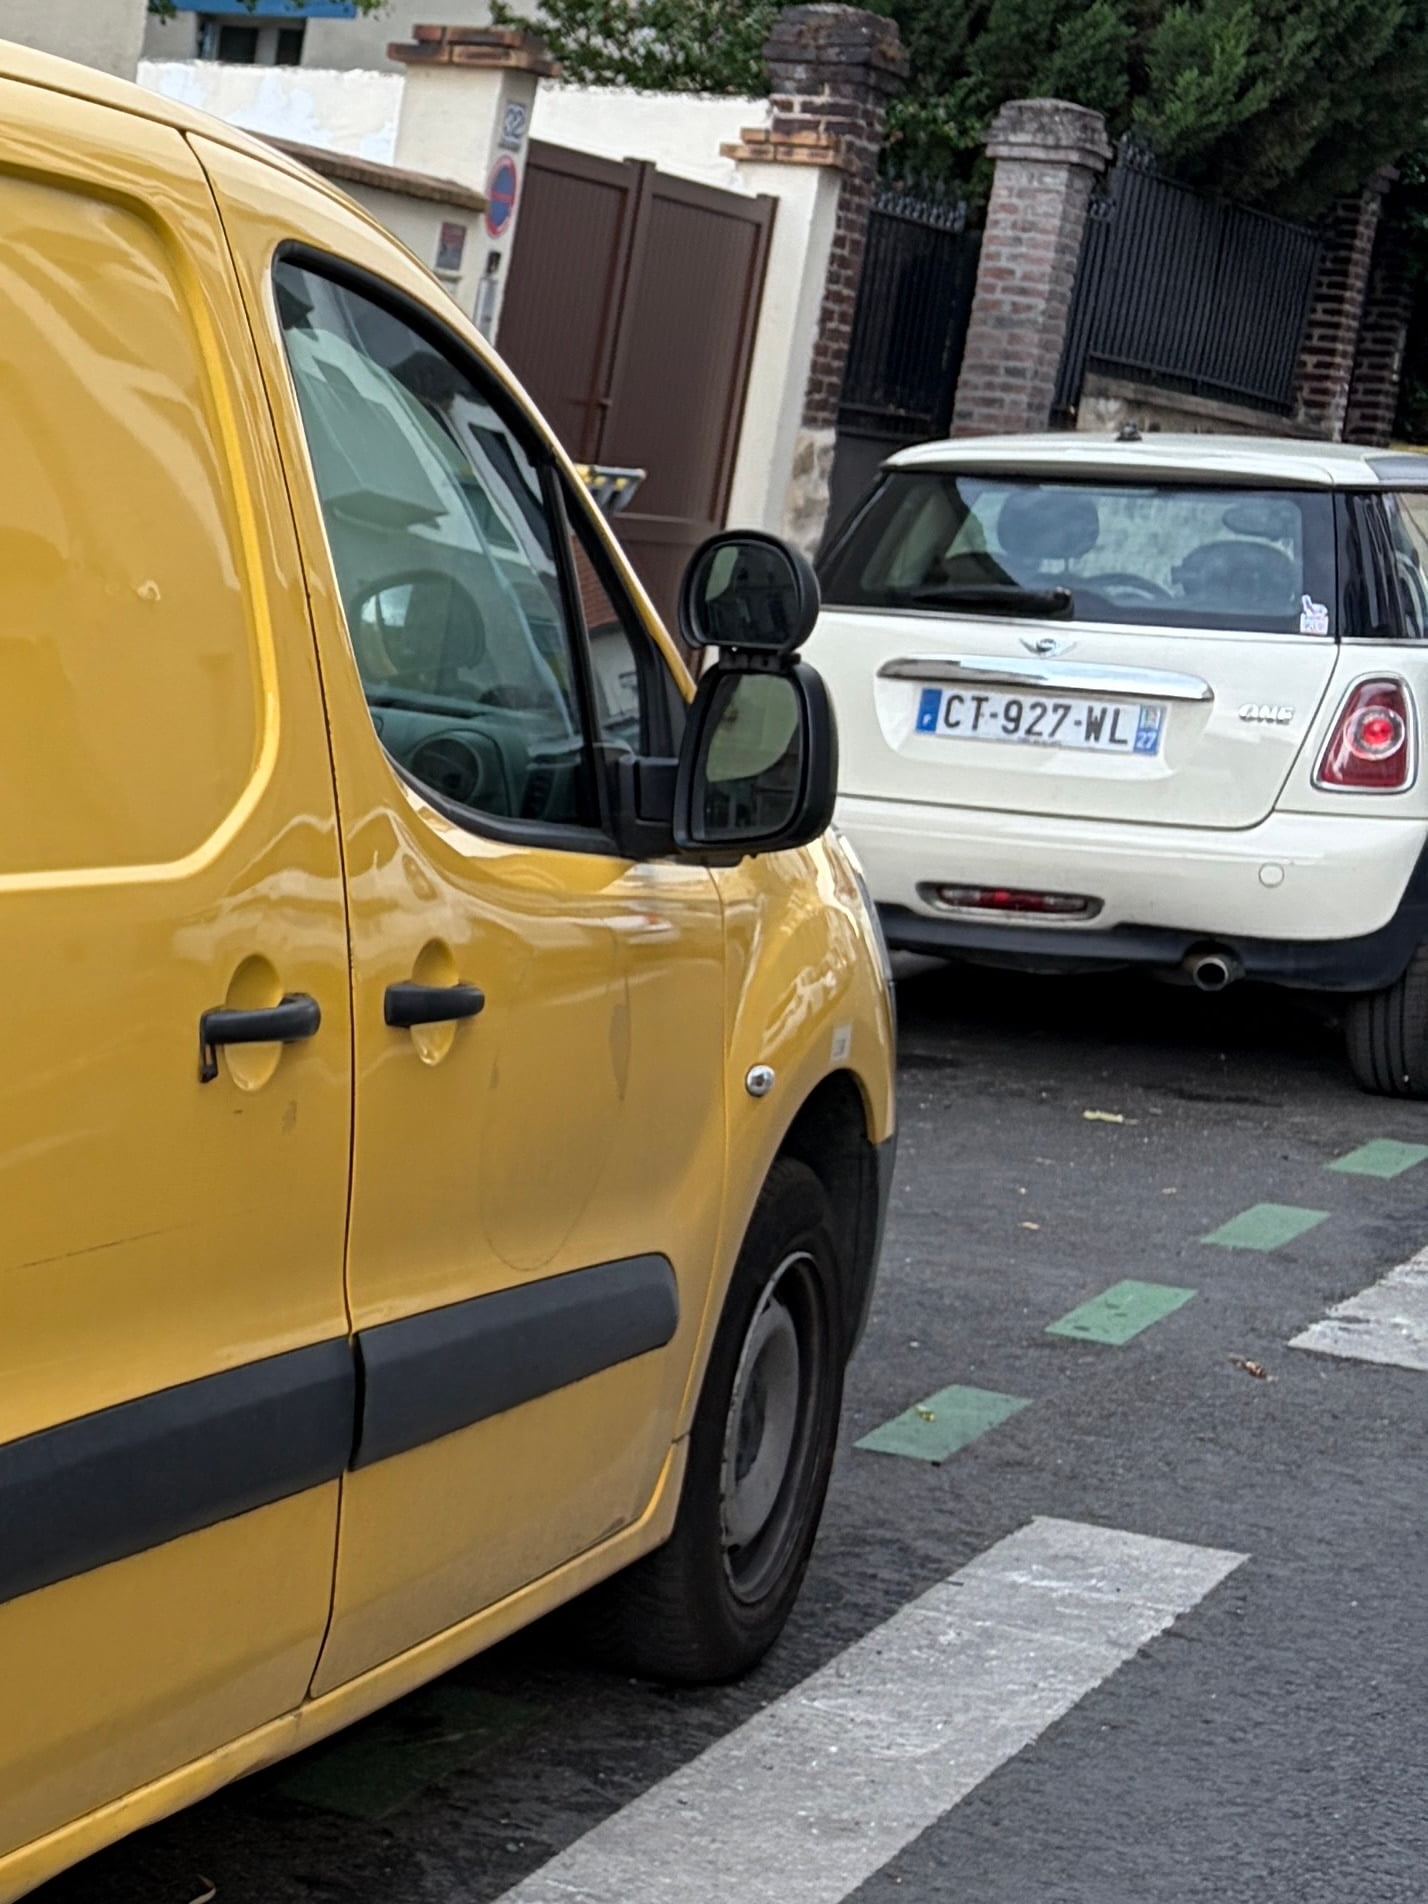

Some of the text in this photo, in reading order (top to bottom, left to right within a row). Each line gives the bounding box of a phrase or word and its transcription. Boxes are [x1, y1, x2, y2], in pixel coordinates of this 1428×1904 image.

[944, 694, 1128, 745] CT-927-WL
[1238, 703, 1295, 726] ONE
[1136, 730, 1157, 749] 27
